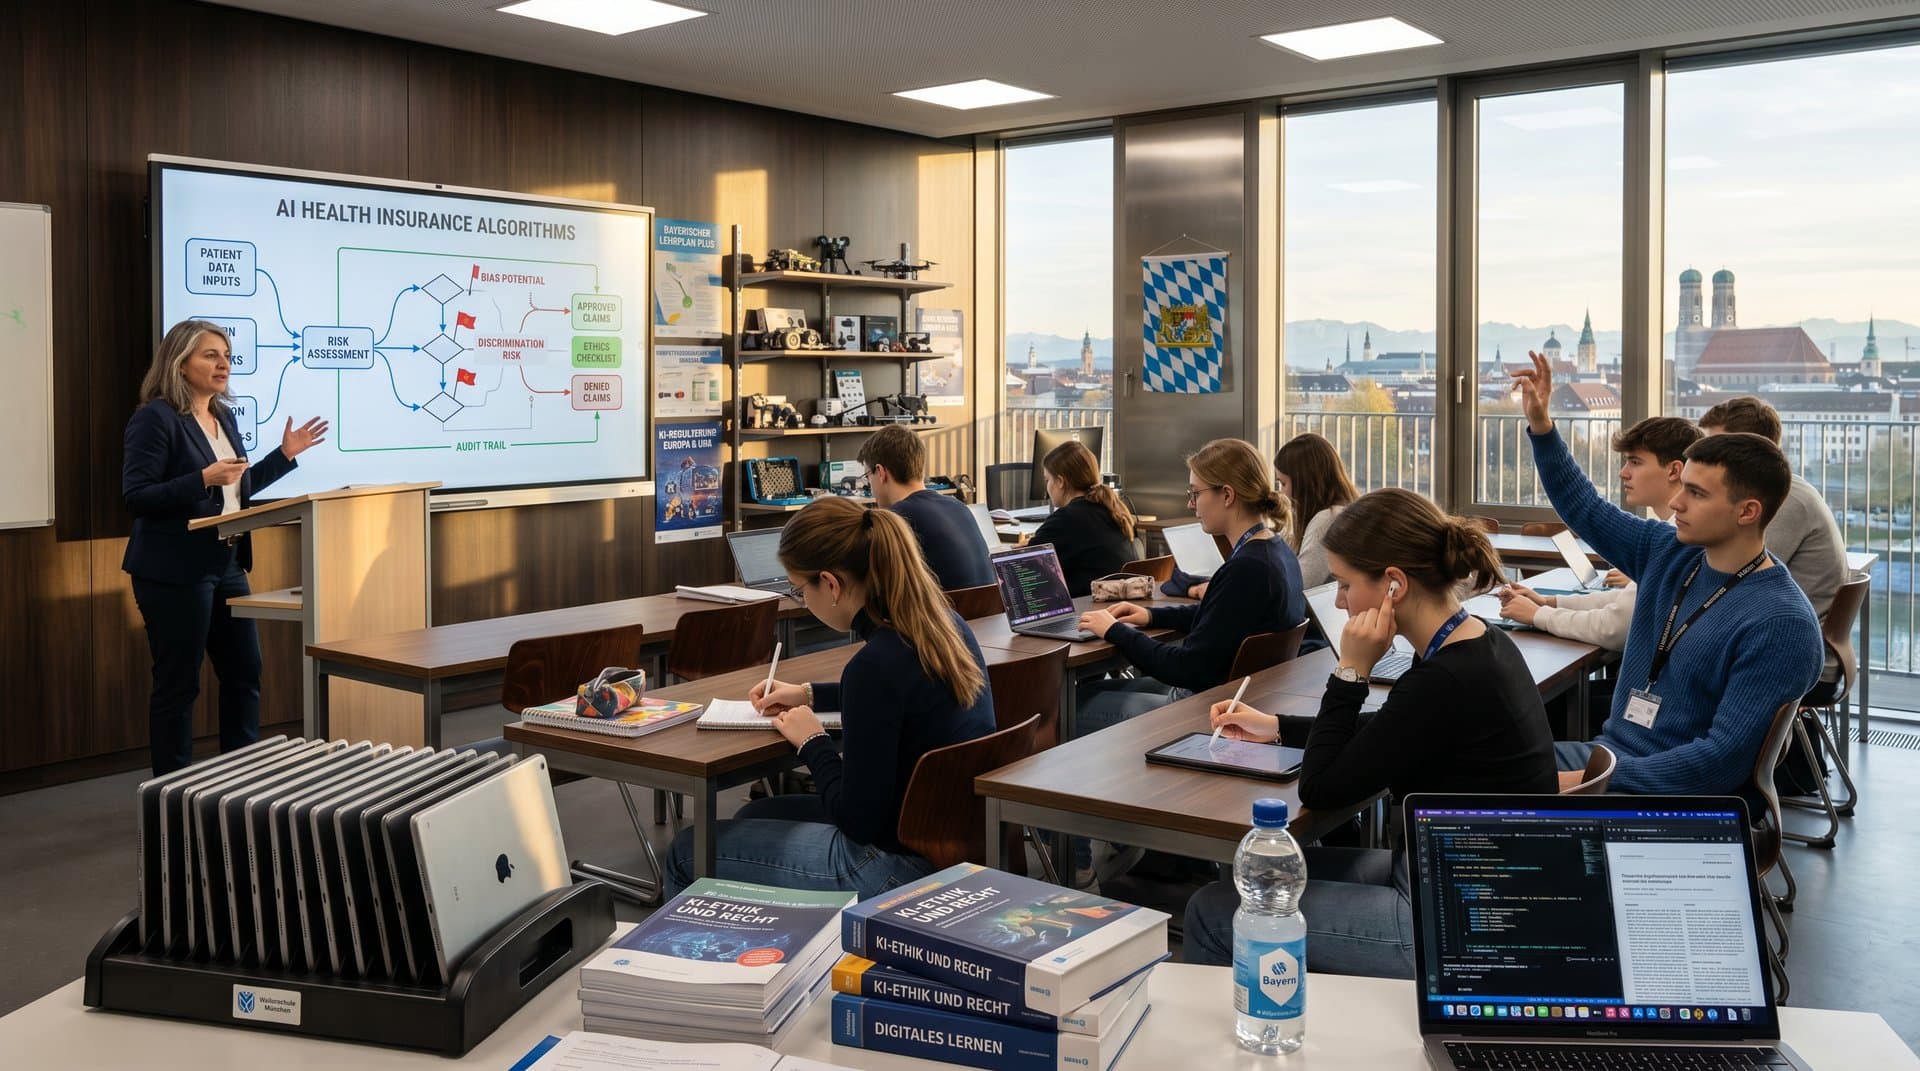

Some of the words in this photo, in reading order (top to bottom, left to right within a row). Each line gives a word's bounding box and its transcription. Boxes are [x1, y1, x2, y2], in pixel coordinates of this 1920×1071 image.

[276, 198, 296, 218] AI
[302, 201, 371, 224] HEALTH
[377, 207, 473, 232] INSURANCE
[477, 216, 576, 241] ALGORITHMS
[663, 225, 712, 238] BAYERISCHER
[659, 235, 696, 248] LEHRPLAN
[697, 239, 716, 249] PLUS
[200, 247, 243, 260] PATIENT
[208, 262, 235, 273] DATA
[202, 275, 241, 287] INPUTS
[481, 272, 501, 284] BIAS
[501, 274, 545, 286] POTENTIAL
[577, 302, 617, 313] APPROVED
[582, 313, 611, 323] CLAIMS
[327, 336, 349, 347] RISK
[478, 338, 545, 349] DISCRIMINATION
[583, 342, 610, 351] ETHICS
[307, 349, 370, 360] ASSESSMENT
[502, 350, 521, 360] RISK
[576, 353, 617, 363] CHECKLIST
[583, 382, 610, 391] DENIED
[583, 392, 611, 402] CLAIMS
[456, 442, 481, 451] AUDIT
[482, 441, 507, 450] TRAIL
[663, 440, 691, 450] EUROPA
[684, 897, 764, 915] KI-ETHIK
[894, 887, 971, 918] KI-ETHIK
[912, 906, 955, 923] UND
[948, 886, 1001, 909] RECHT
[676, 905, 717, 918] UND
[718, 911, 780, 925] RECHT
[876, 935, 924, 962] KI-ETHIK
[926, 951, 951, 969] UND
[953, 958, 992, 982] RECHT
[1262, 976, 1297, 987] Bayern
[874, 980, 930, 1002] KI-ETHIK
[934, 990, 962, 1008] UND
[967, 998, 1011, 1017] RECHT
[874, 1021, 944, 1045] DIGITALES
[947, 1032, 1003, 1055] LERNEN
